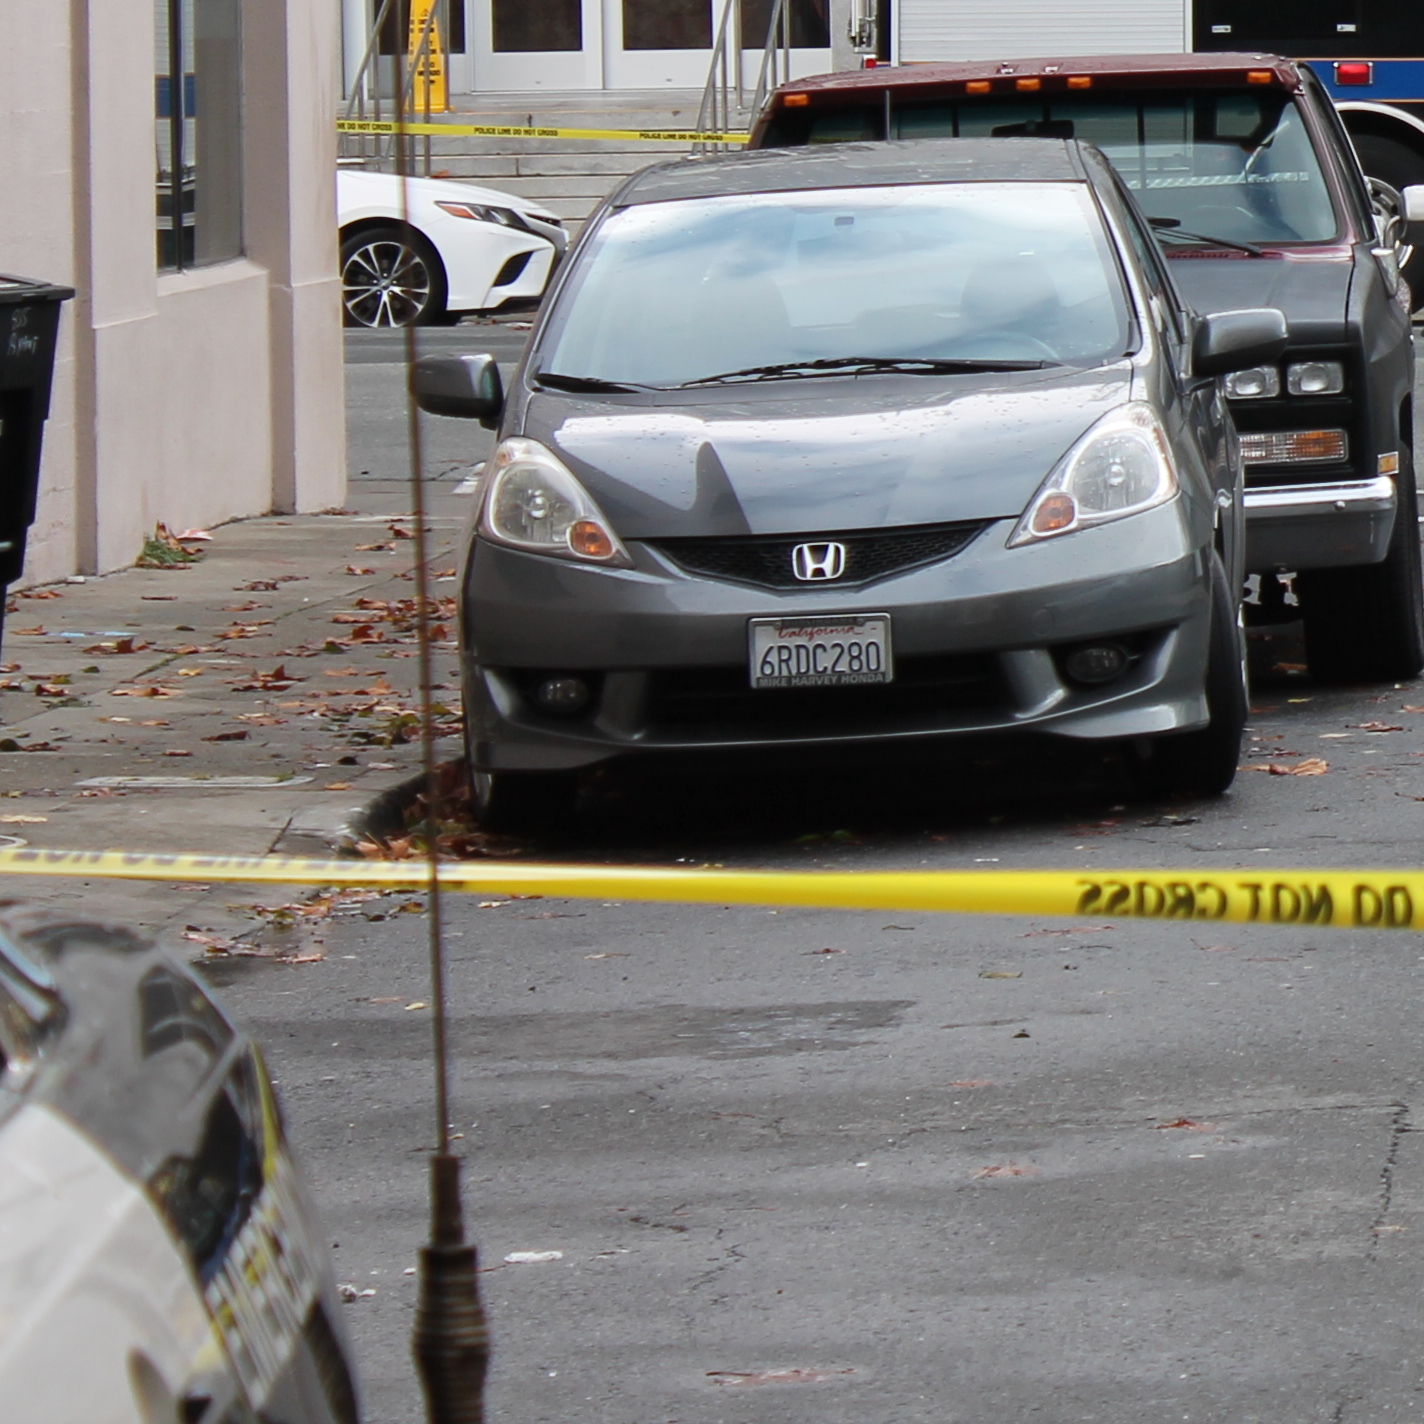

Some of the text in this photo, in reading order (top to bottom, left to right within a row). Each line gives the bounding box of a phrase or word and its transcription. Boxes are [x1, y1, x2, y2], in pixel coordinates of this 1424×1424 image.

[777, 626, 863, 642] California
[760, 641, 881, 677] 6RDC280
[759, 673, 884, 687] MIKE HARVEY HONDA
